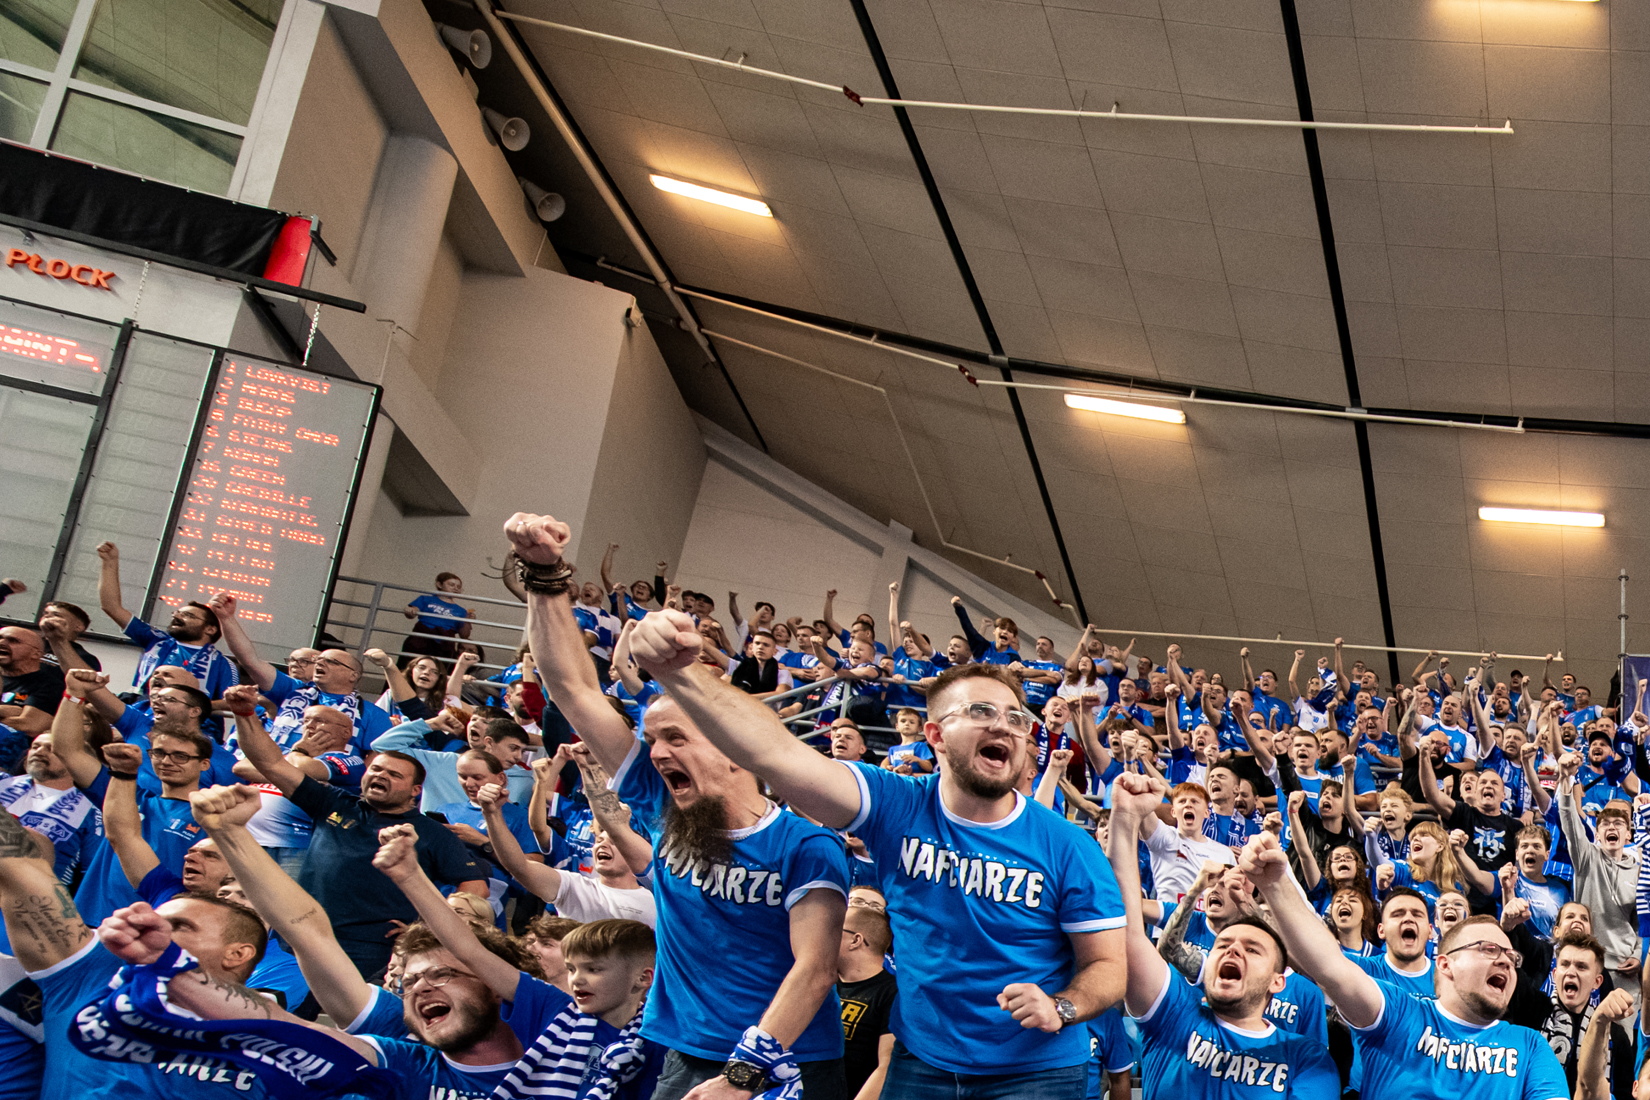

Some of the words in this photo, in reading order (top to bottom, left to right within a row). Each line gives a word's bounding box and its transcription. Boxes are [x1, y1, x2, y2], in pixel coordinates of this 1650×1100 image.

[658, 842, 783, 906] AFCIARZE
[897, 837, 1045, 908] NAFCIARZE
[1417, 1026, 1519, 1078] NAFCIARZE
